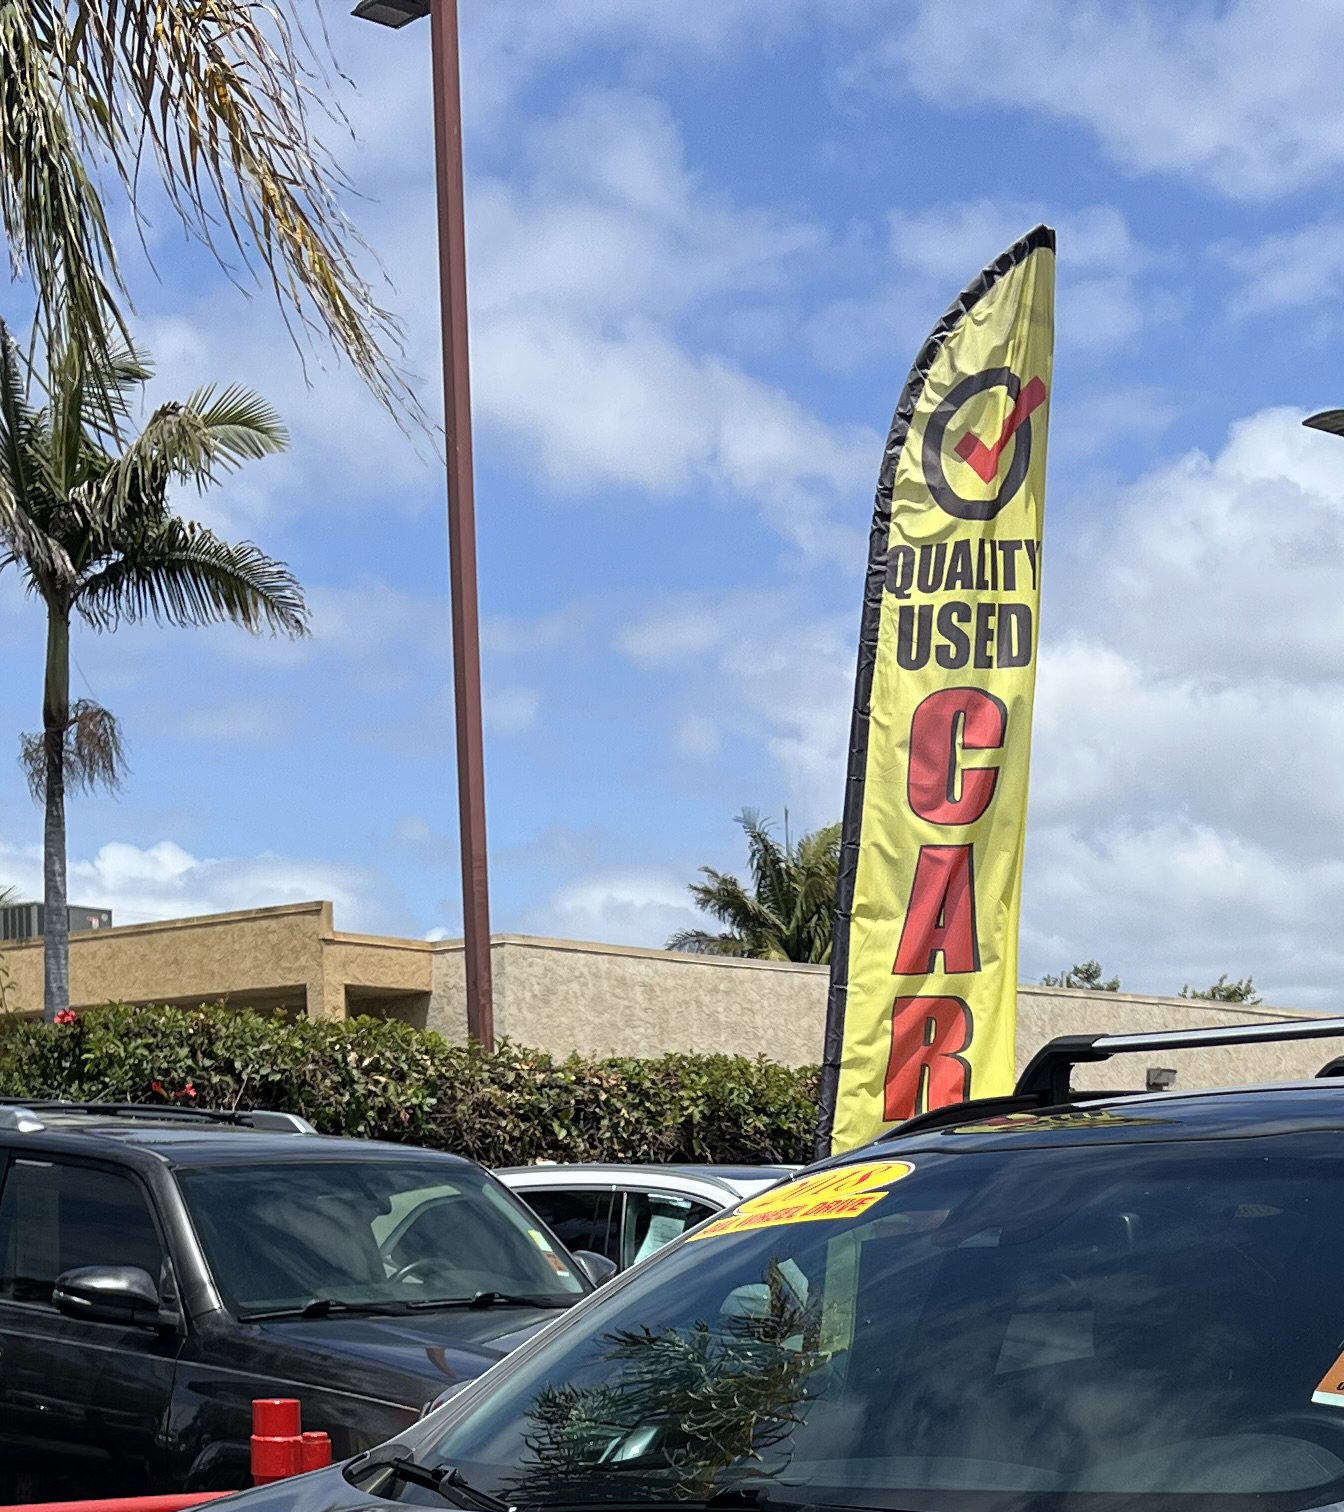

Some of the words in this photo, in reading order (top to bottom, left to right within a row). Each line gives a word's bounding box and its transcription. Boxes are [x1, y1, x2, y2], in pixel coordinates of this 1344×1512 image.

[885, 539, 1041, 599] QUALITY
[896, 602, 1032, 672] USED
[801, 1196, 875, 1216] DRIVE
